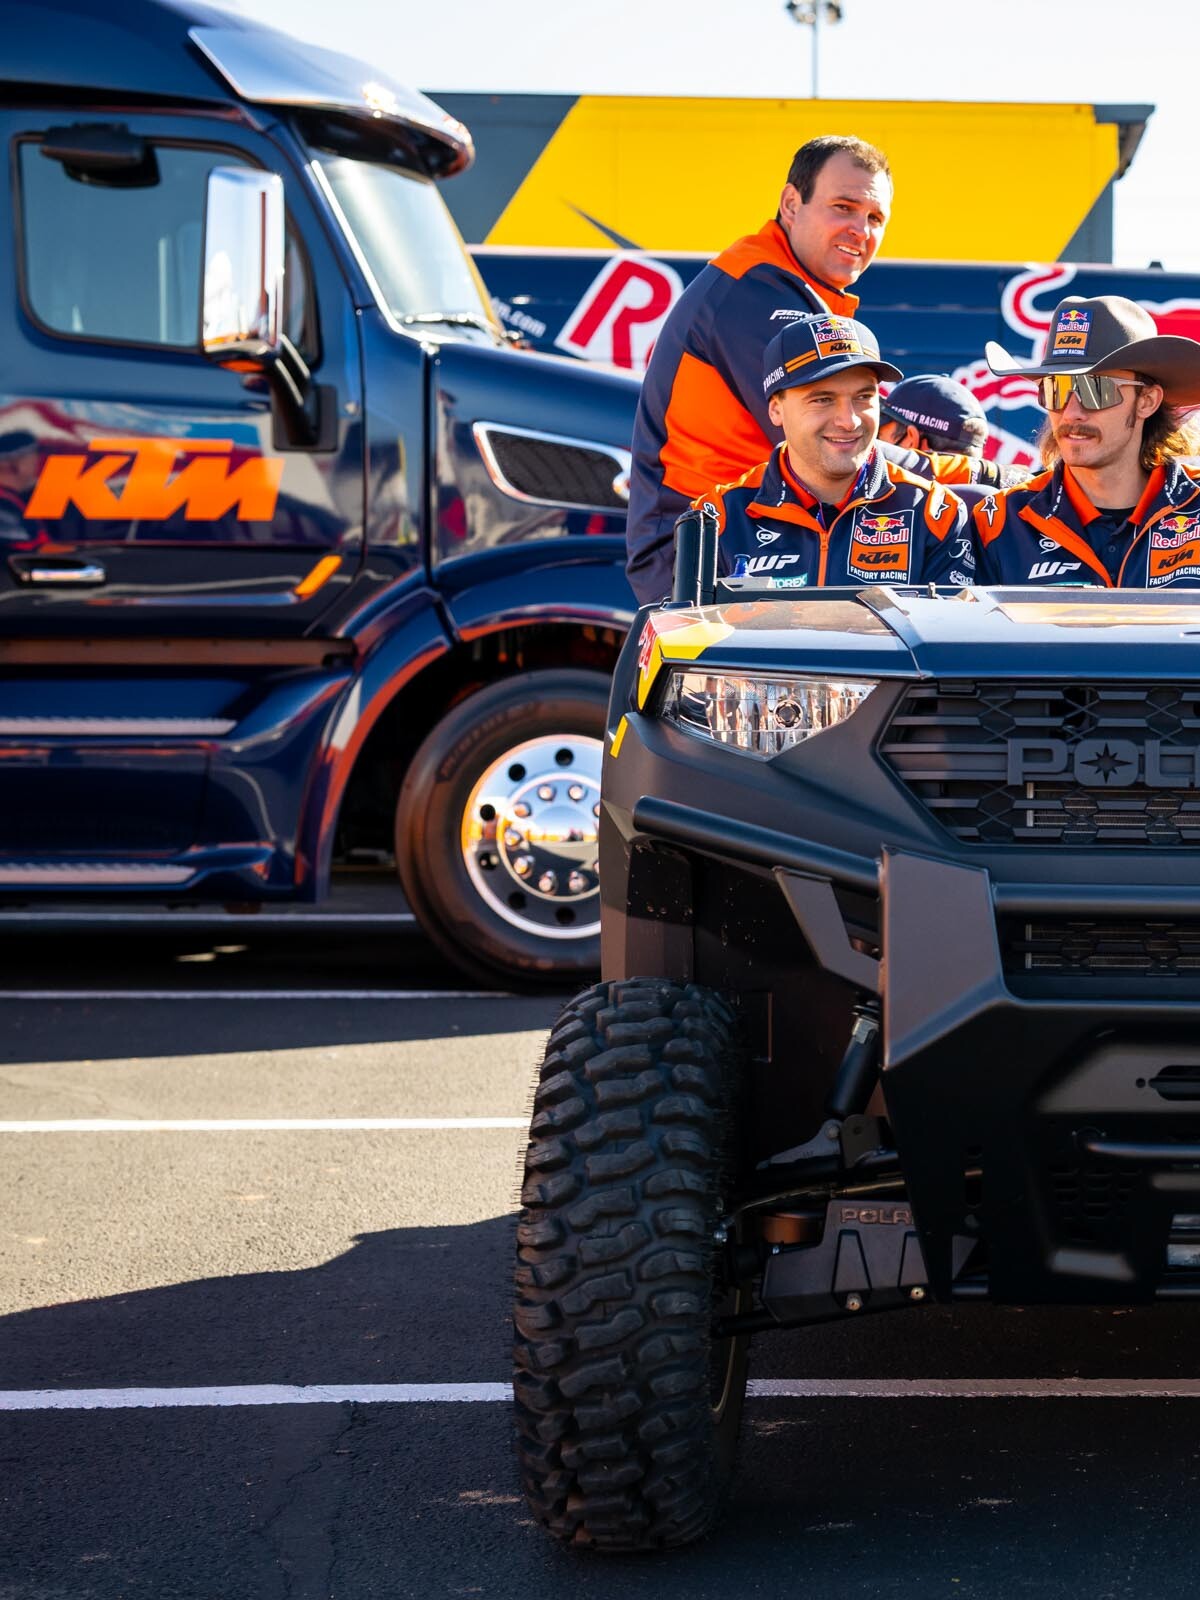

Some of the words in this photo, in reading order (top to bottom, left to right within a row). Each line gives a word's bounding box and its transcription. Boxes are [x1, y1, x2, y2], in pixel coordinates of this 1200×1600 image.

[1056, 322, 1071, 332] Red
[1071, 322, 1090, 332] Bull
[816, 330, 837, 342] Red
[1058, 335, 1082, 345] KTM
[829, 343, 851, 352] KTM
[920, 415, 950, 432] RACING
[23, 437, 286, 521] KTM
[854, 525, 881, 544] Red
[881, 528, 909, 544] Bull
[1152, 532, 1180, 549] Red
[748, 554, 800, 573] WP
[857, 550, 899, 564] KTM
[1157, 548, 1193, 569] KTM
[850, 565, 878, 581] FACTORY
[880, 571, 907, 581] RACING
[1028, 561, 1081, 579] WP
[1149, 572, 1175, 586] FACTORY
[1175, 567, 1200, 579] RACING
[771, 576, 807, 588] TOREX
[841, 1208, 914, 1225] POLA
